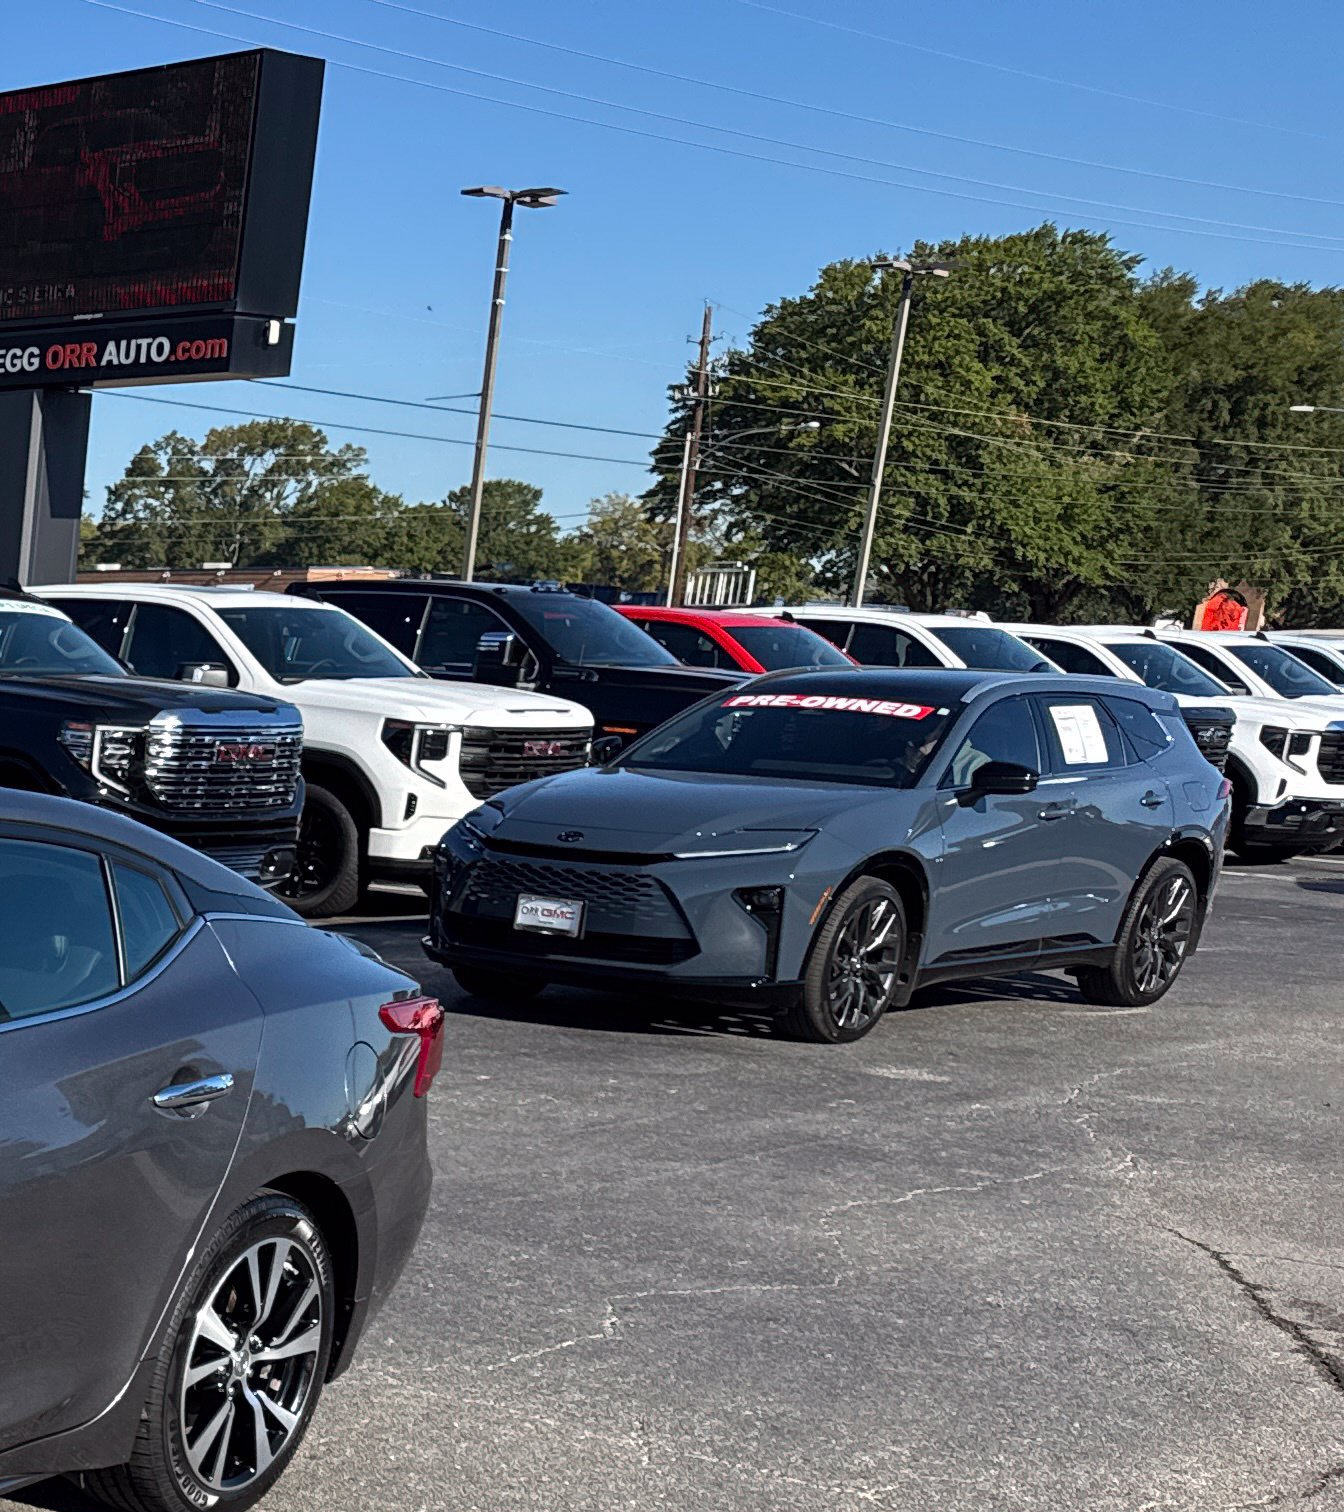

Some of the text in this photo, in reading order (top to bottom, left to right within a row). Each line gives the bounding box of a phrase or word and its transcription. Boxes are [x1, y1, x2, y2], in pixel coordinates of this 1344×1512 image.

[45, 342, 98, 370] ORR
[100, 336, 228, 367] AUTO.com
[729, 695, 922, 718] PRE-OWNED
